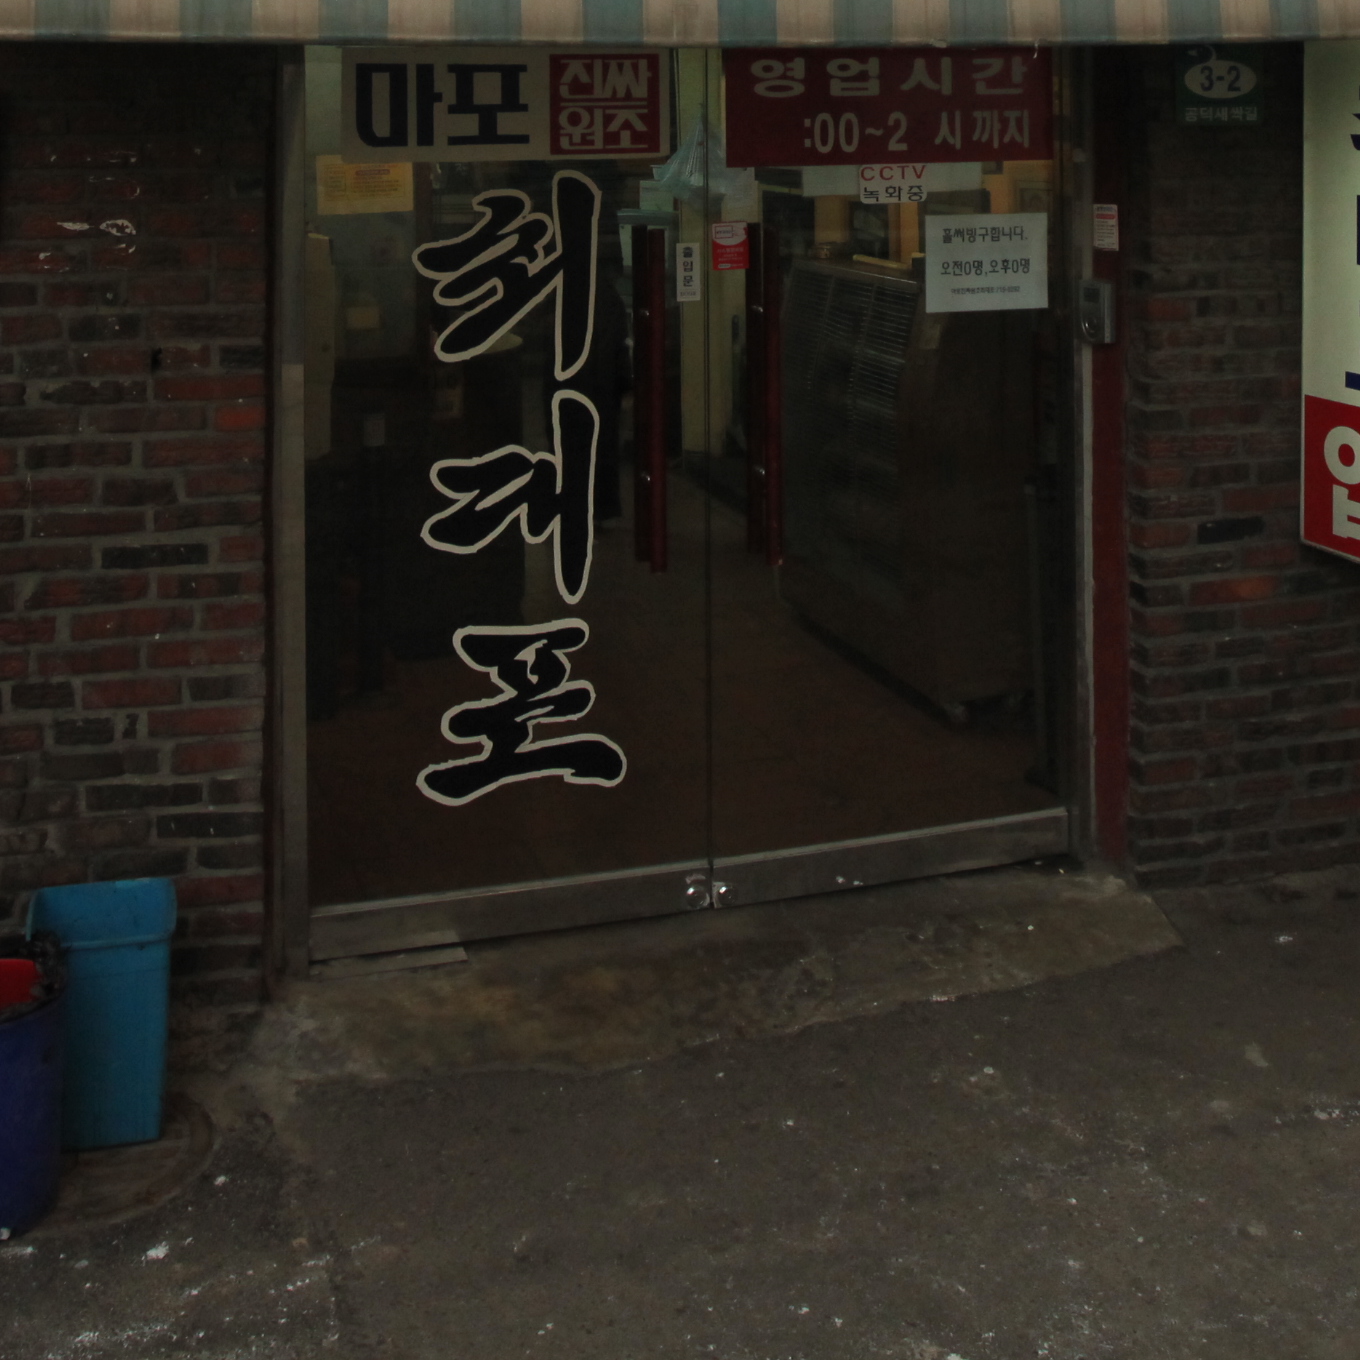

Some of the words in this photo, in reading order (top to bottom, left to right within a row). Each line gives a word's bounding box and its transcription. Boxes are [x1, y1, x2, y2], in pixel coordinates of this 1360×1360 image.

[560, 58, 652, 100] 진짜
[749, 55, 1028, 98] 영업시간
[1199, 65, 1242, 92] 3-2
[356, 63, 530, 148] 마포
[558, 107, 650, 150] 원조
[860, 164, 927, 181] CCTV
[862, 184, 925, 203] 녹화중
[411, 169, 627, 806] 최대포
